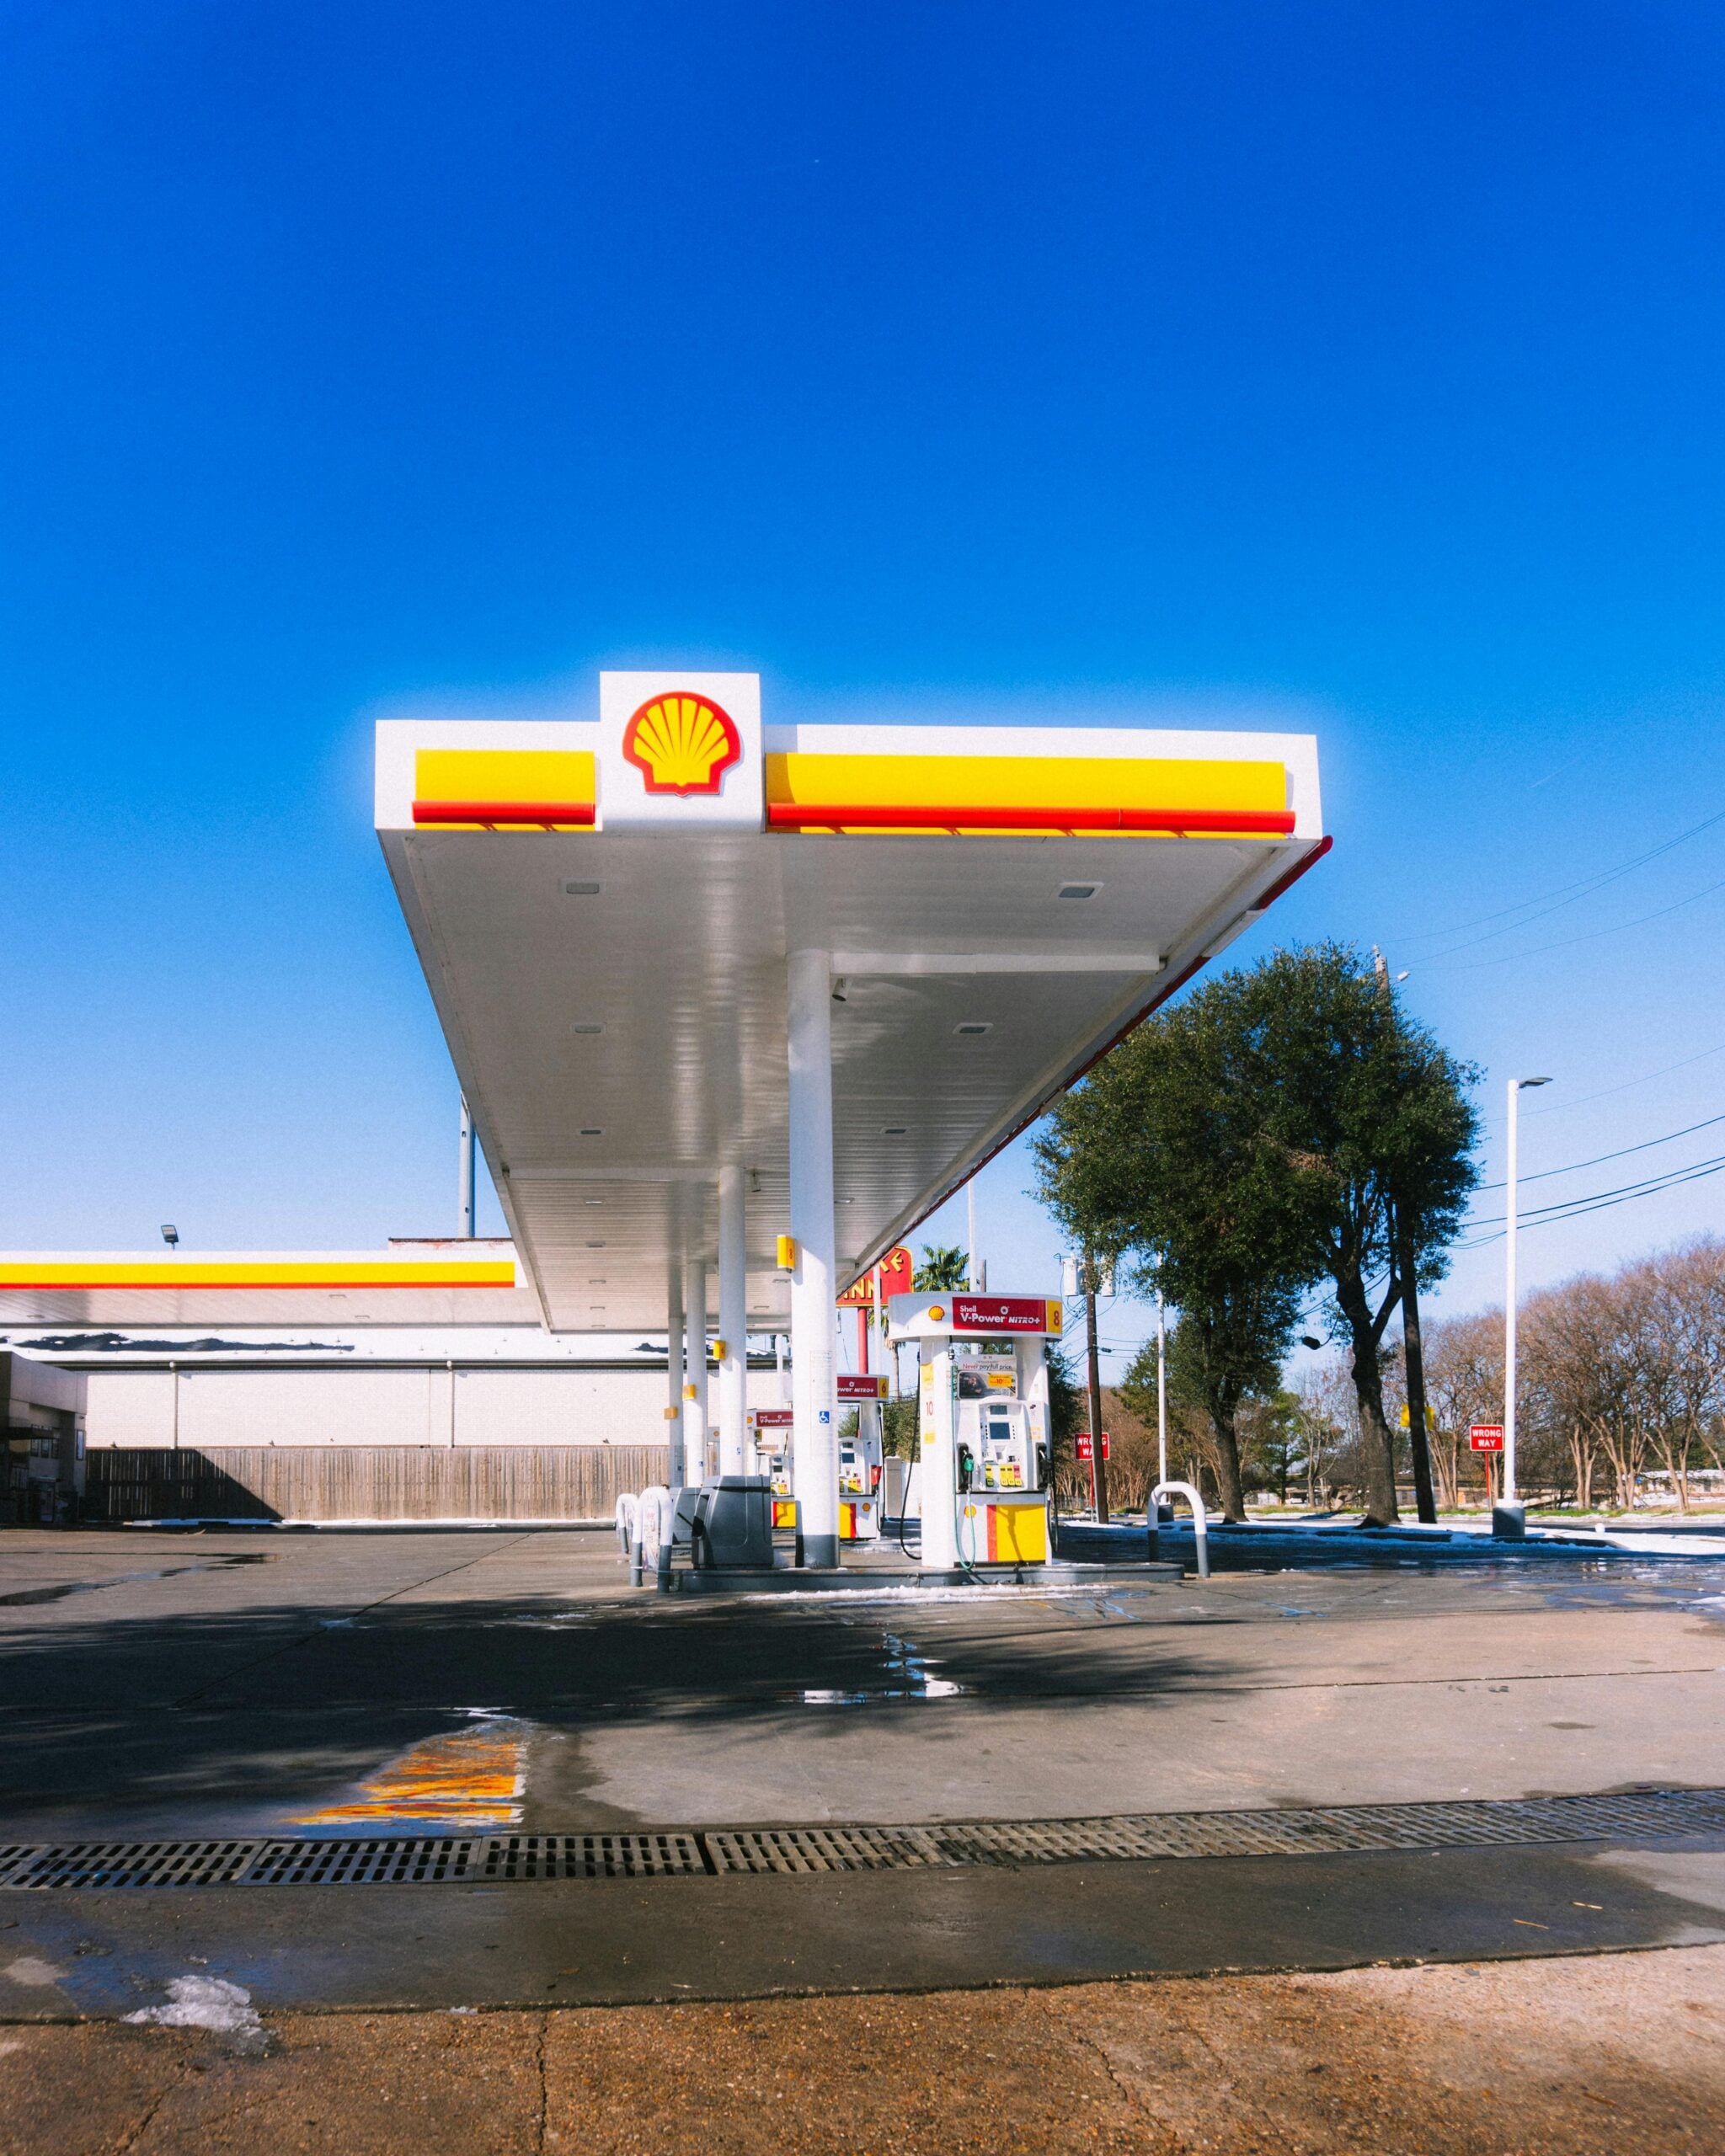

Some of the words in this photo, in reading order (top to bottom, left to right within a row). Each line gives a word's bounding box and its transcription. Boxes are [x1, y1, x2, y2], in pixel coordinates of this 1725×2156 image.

[960, 1313, 1005, 1323] V-Power
[1054, 1310, 1060, 1326] 8
[881, 1383, 887, 1393] 6
[926, 1401, 933, 1416] 10
[1077, 1437, 1107, 1446] WROG
